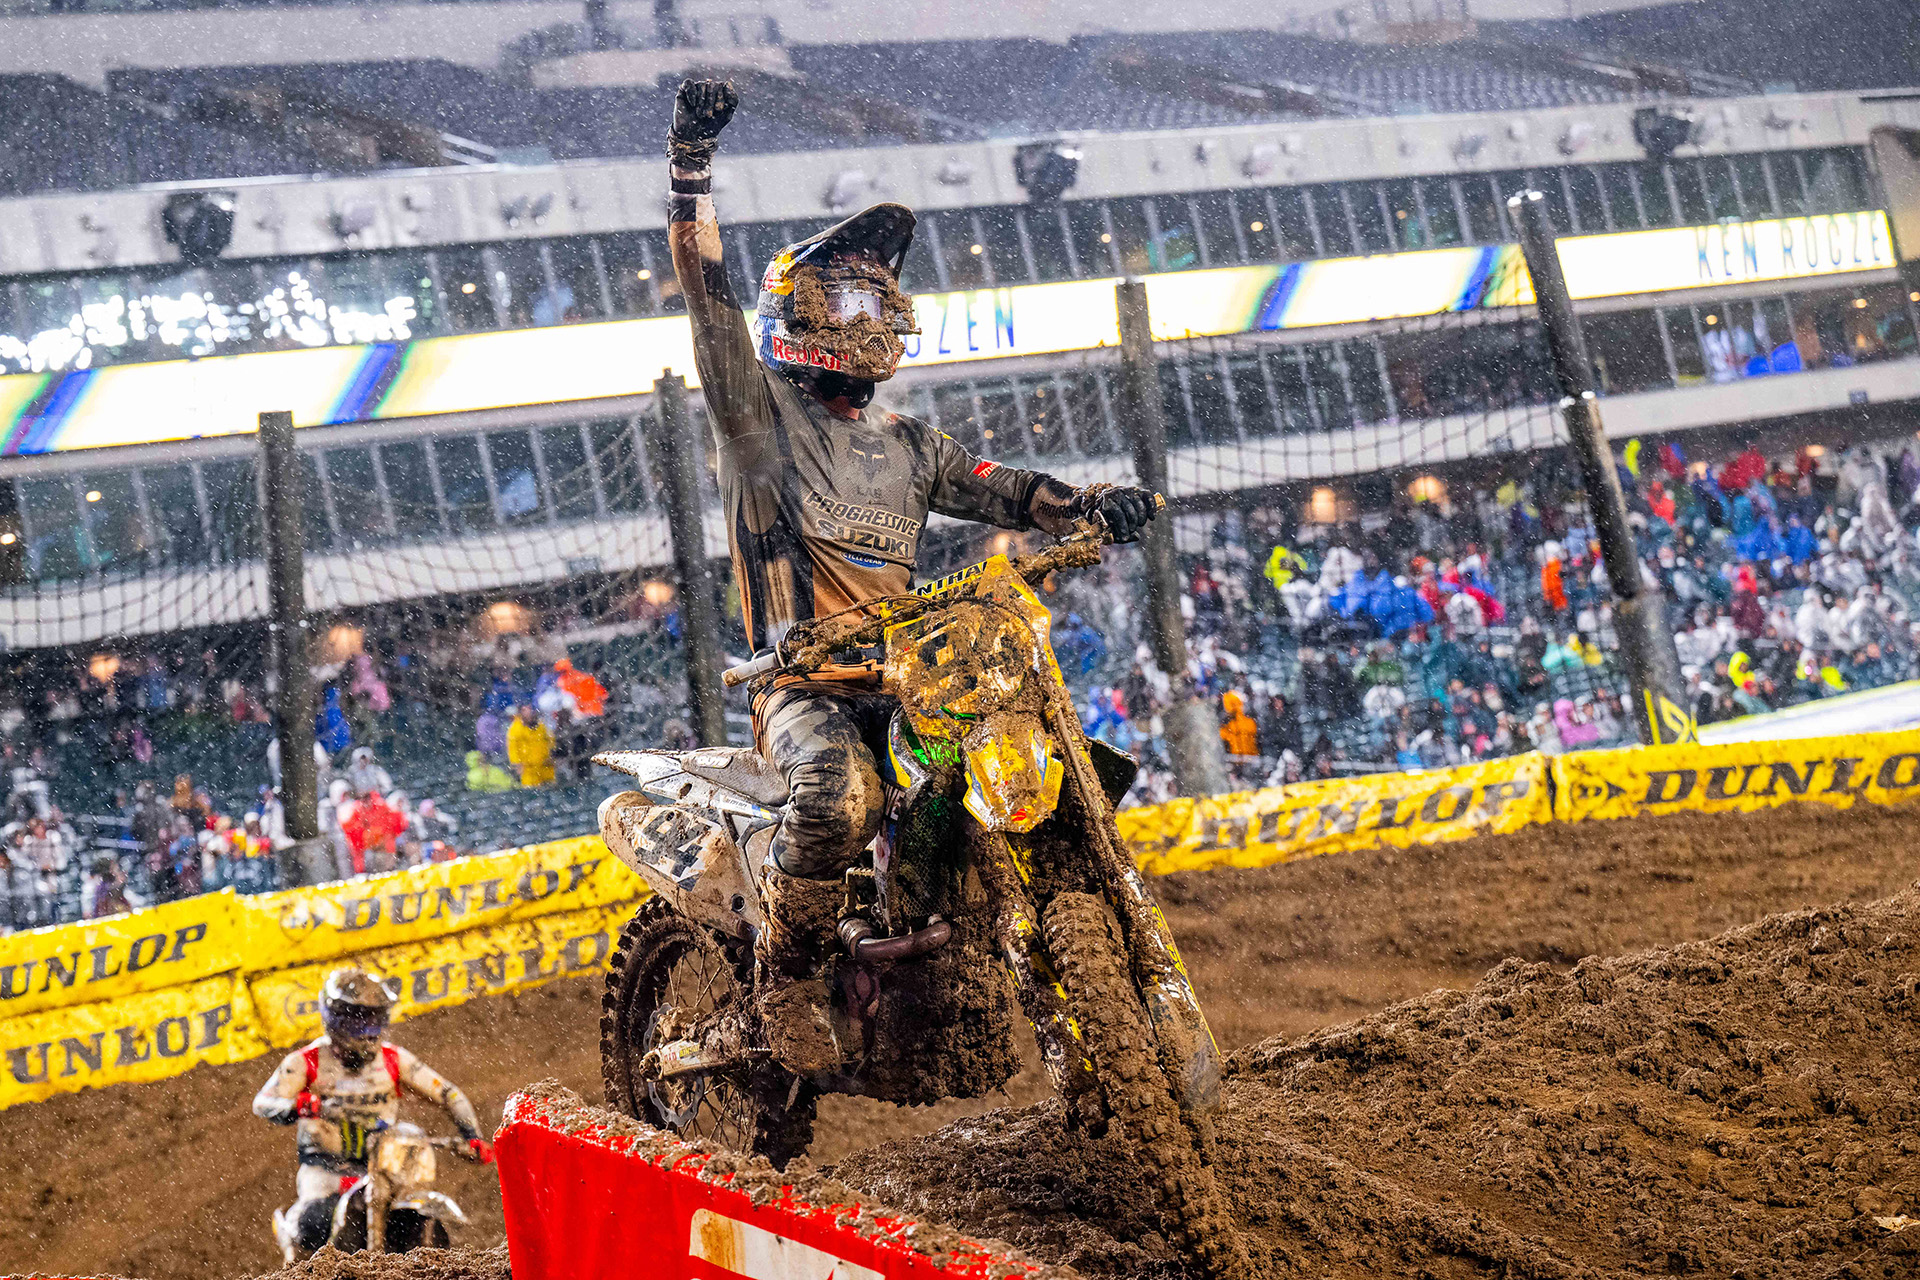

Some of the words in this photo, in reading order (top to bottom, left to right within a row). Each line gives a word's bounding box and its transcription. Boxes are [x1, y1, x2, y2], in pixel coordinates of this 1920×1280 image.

[1697, 221, 1758, 278] KEN
[772, 335, 808, 364] Red
[804, 489, 919, 538] PROGRESSIVE
[816, 518, 910, 559] SUZUKI
[842, 551, 866, 562] CYCLE
[865, 556, 883, 566] GEAR
[335, 858, 602, 932] DUNLOP
